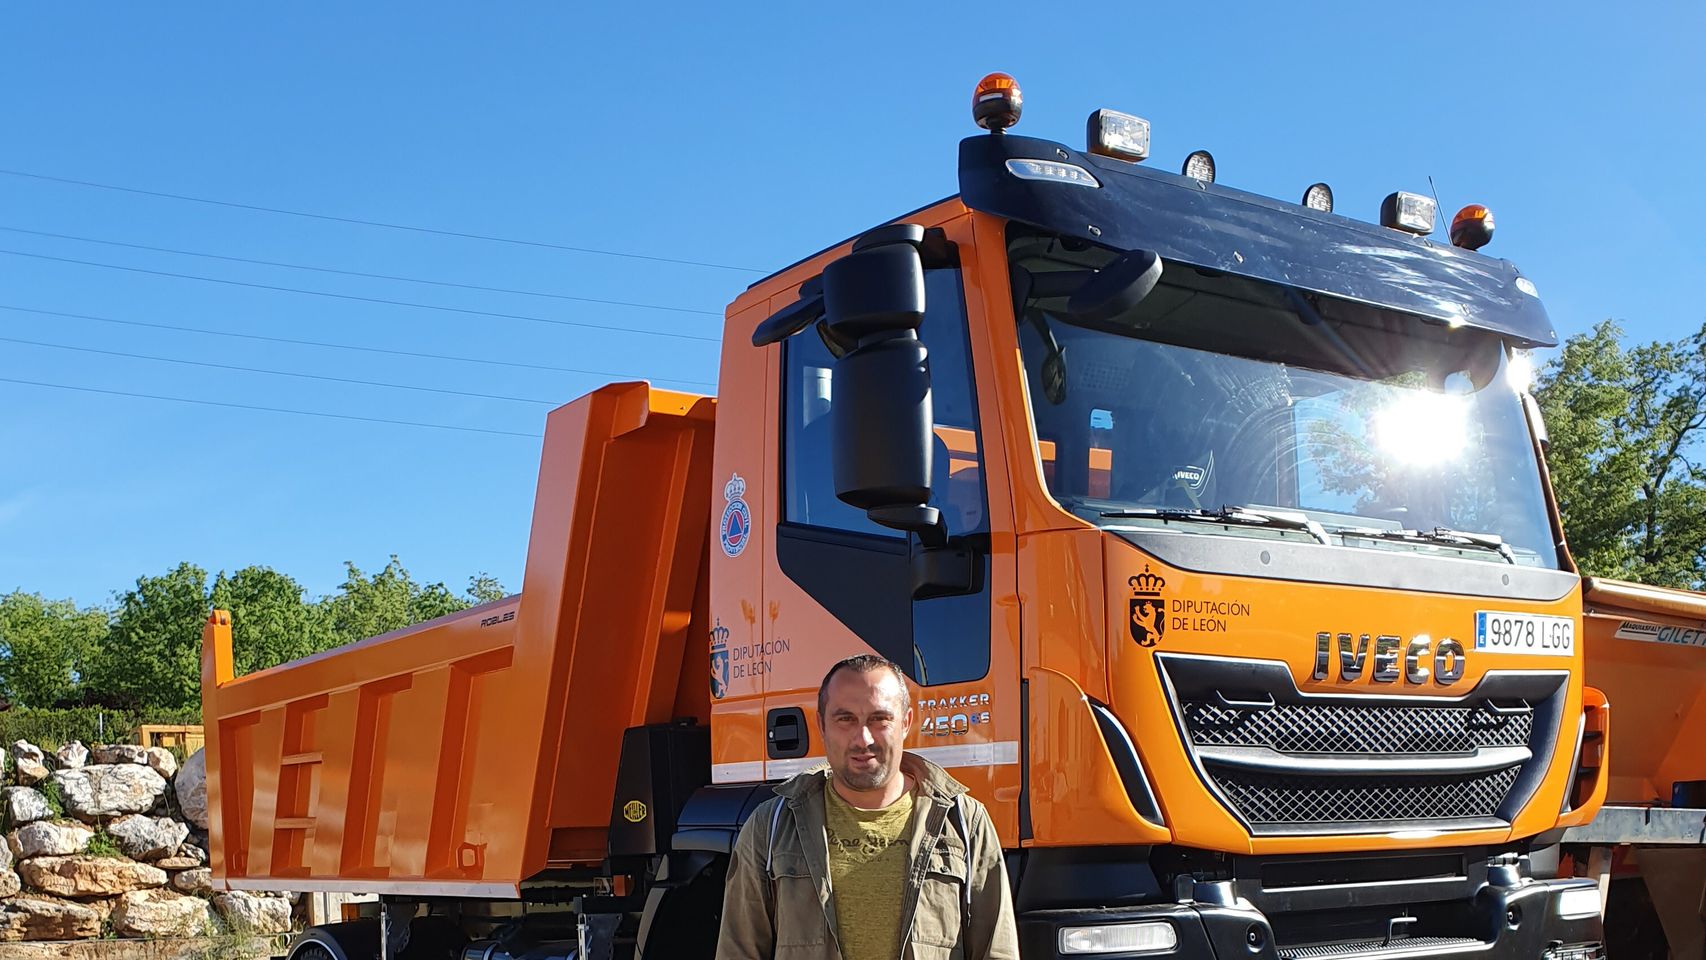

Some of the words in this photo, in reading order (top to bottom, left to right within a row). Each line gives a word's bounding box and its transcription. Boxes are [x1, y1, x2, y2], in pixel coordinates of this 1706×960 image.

[1177, 470, 1200, 481] IVECO
[1172, 600, 1250, 616] DIPUTACIÓN
[480, 611, 516, 628] ROBLES
[1172, 617, 1189, 630] DE
[1192, 615, 1227, 632] LEÓN
[1491, 618, 1535, 647] 9878
[1541, 621, 1570, 649] LGG
[733, 637, 790, 661] DIPUTACIÓN
[1313, 631, 1466, 685] IVECO
[733, 665, 745, 679] DE
[917, 693, 989, 711] TRAKKER
[920, 713, 968, 737] 450
